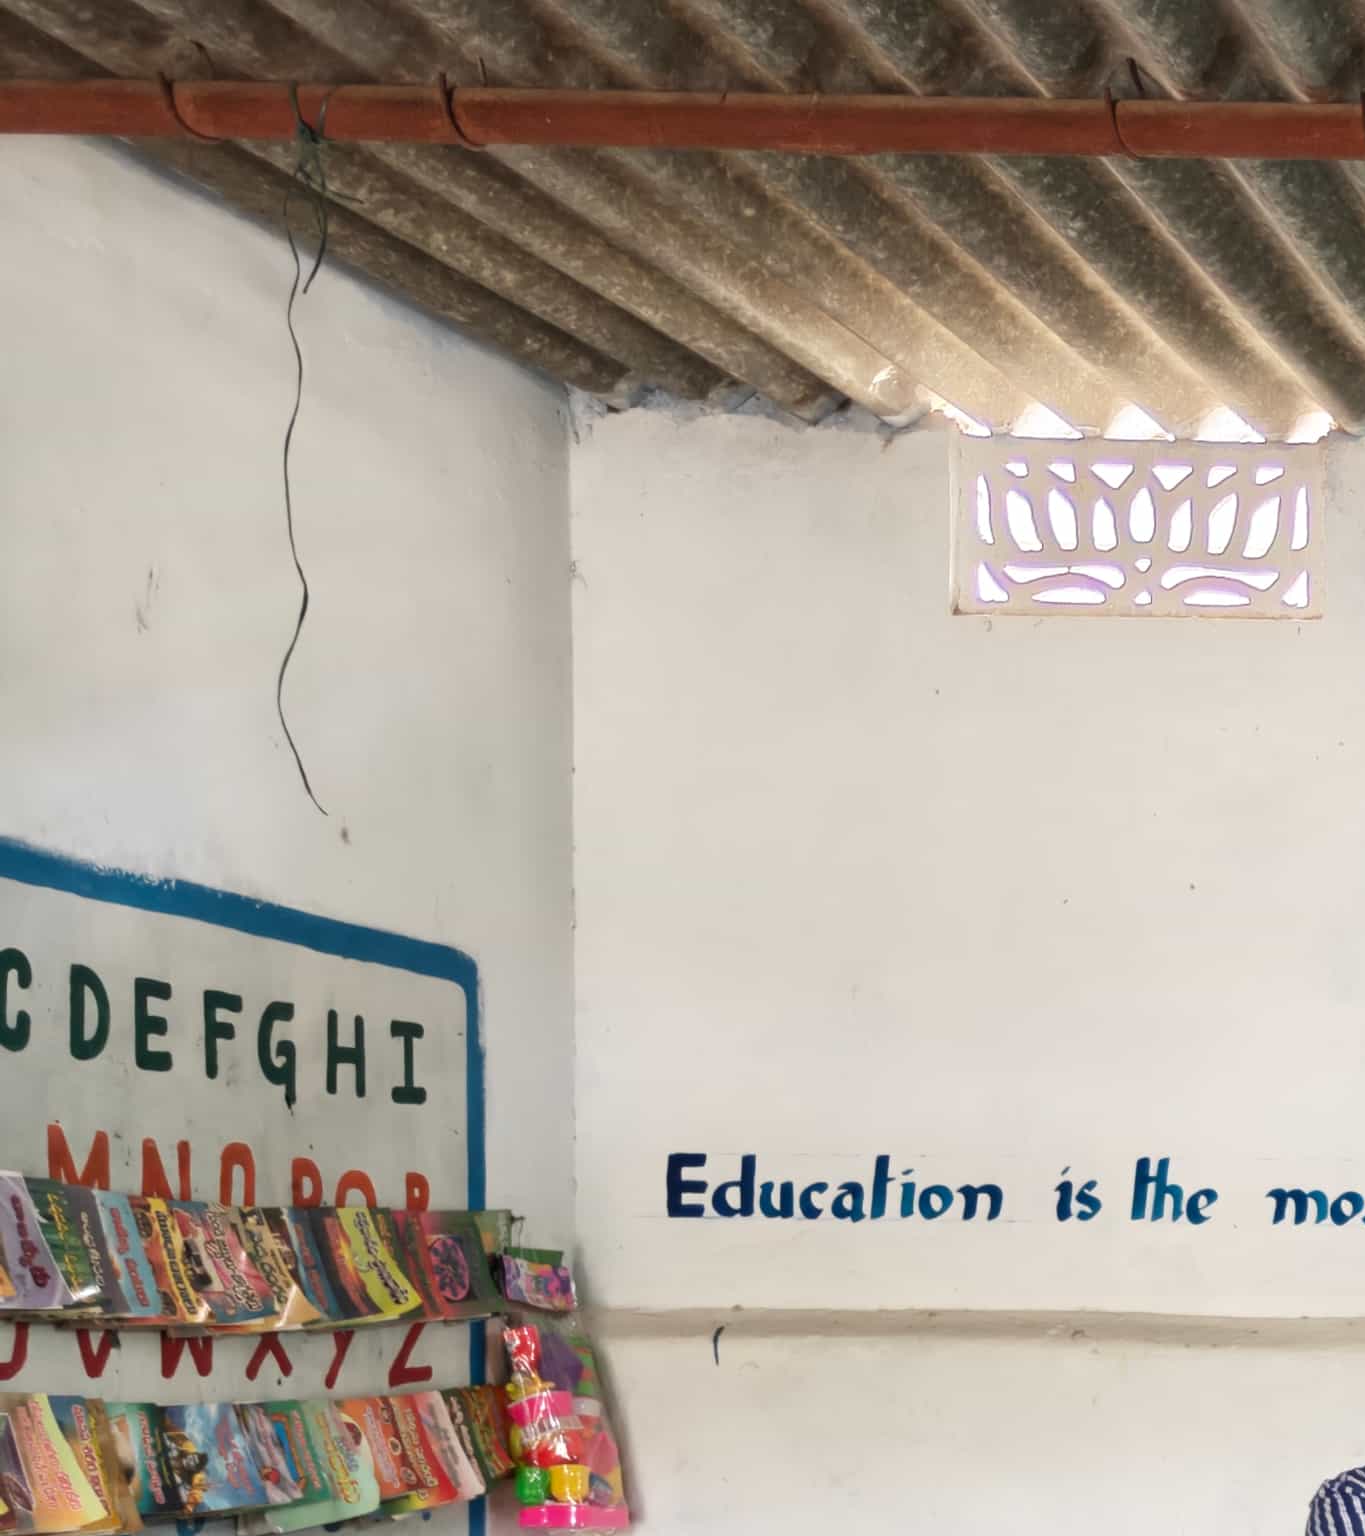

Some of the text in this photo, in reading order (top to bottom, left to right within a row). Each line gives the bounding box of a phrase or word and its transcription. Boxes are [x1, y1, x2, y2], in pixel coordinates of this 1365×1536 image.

[666, 1153, 1002, 1221] Education
[1058, 1166, 1101, 1220] is
[1132, 1158, 1217, 1224] the
